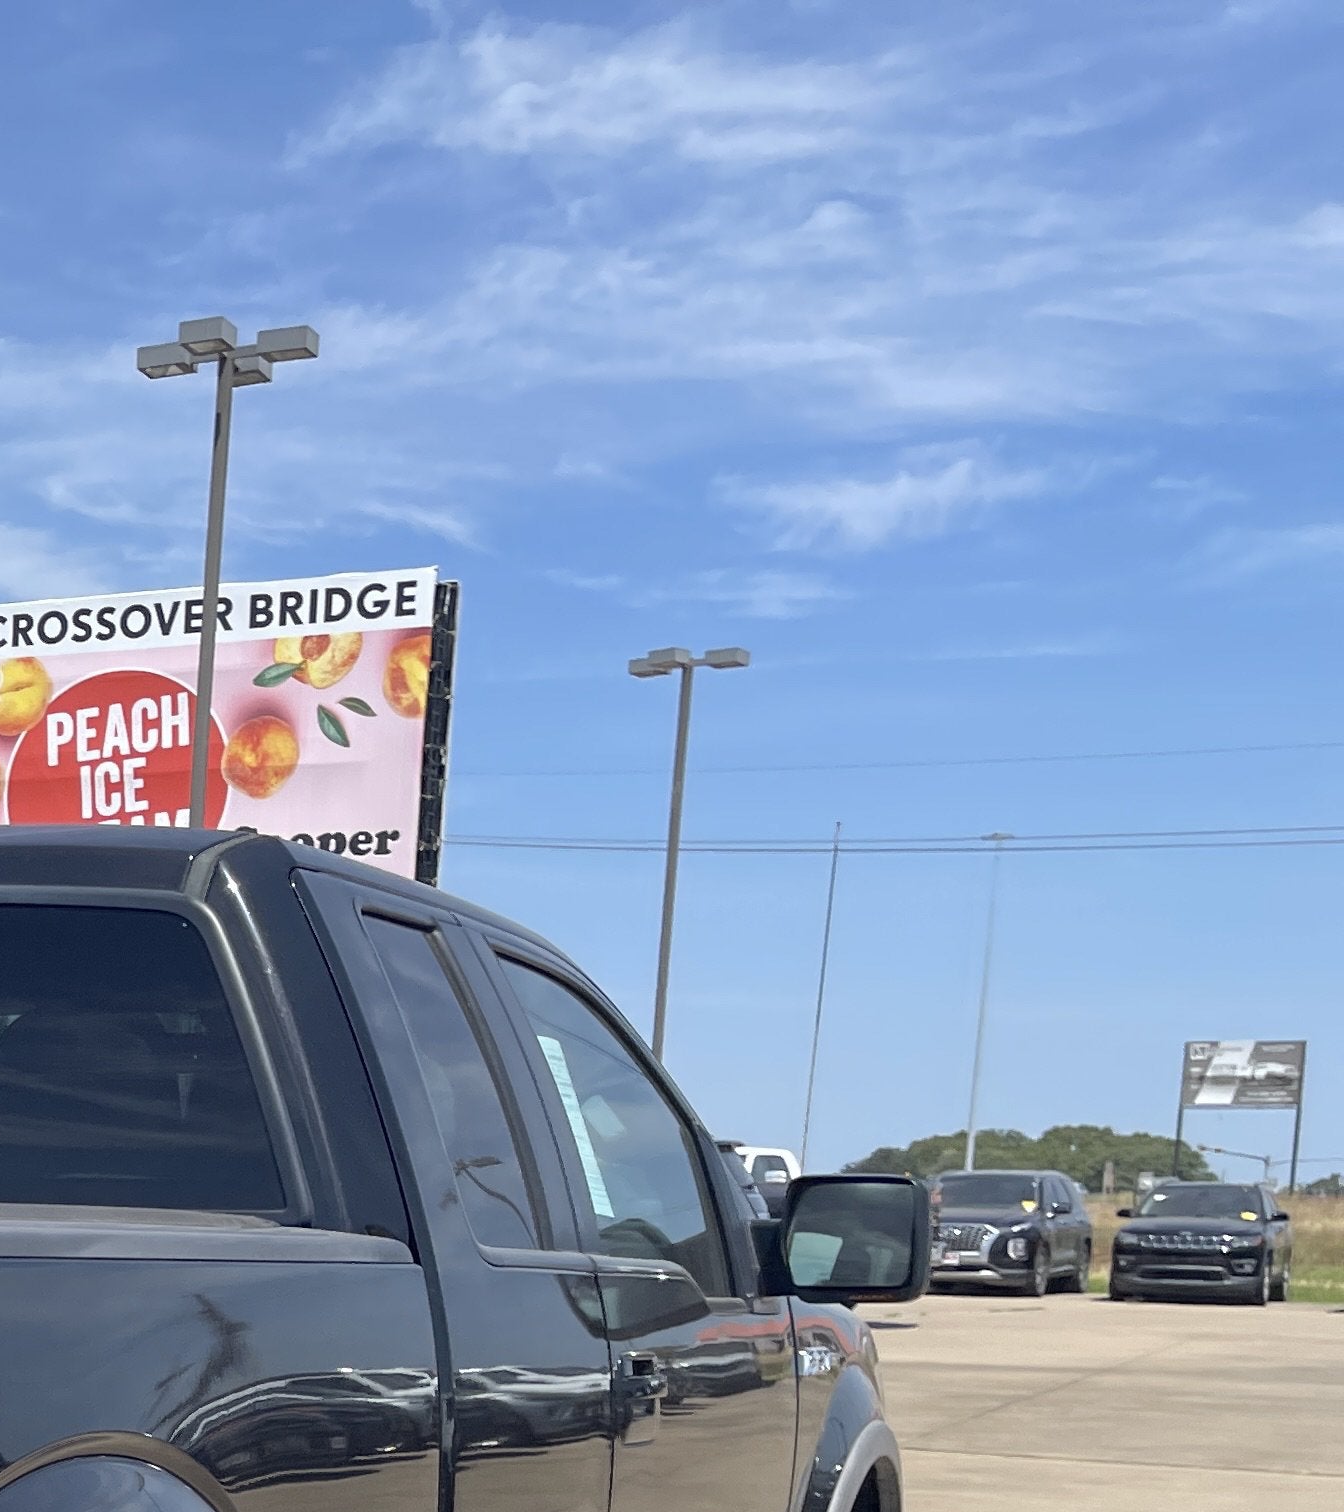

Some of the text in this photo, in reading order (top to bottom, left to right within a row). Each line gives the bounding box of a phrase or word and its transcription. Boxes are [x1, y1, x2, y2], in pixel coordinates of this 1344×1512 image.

[249, 580, 418, 629] BRIDGE
[46, 691, 190, 767] PEACH
[80, 758, 150, 819] ICE
